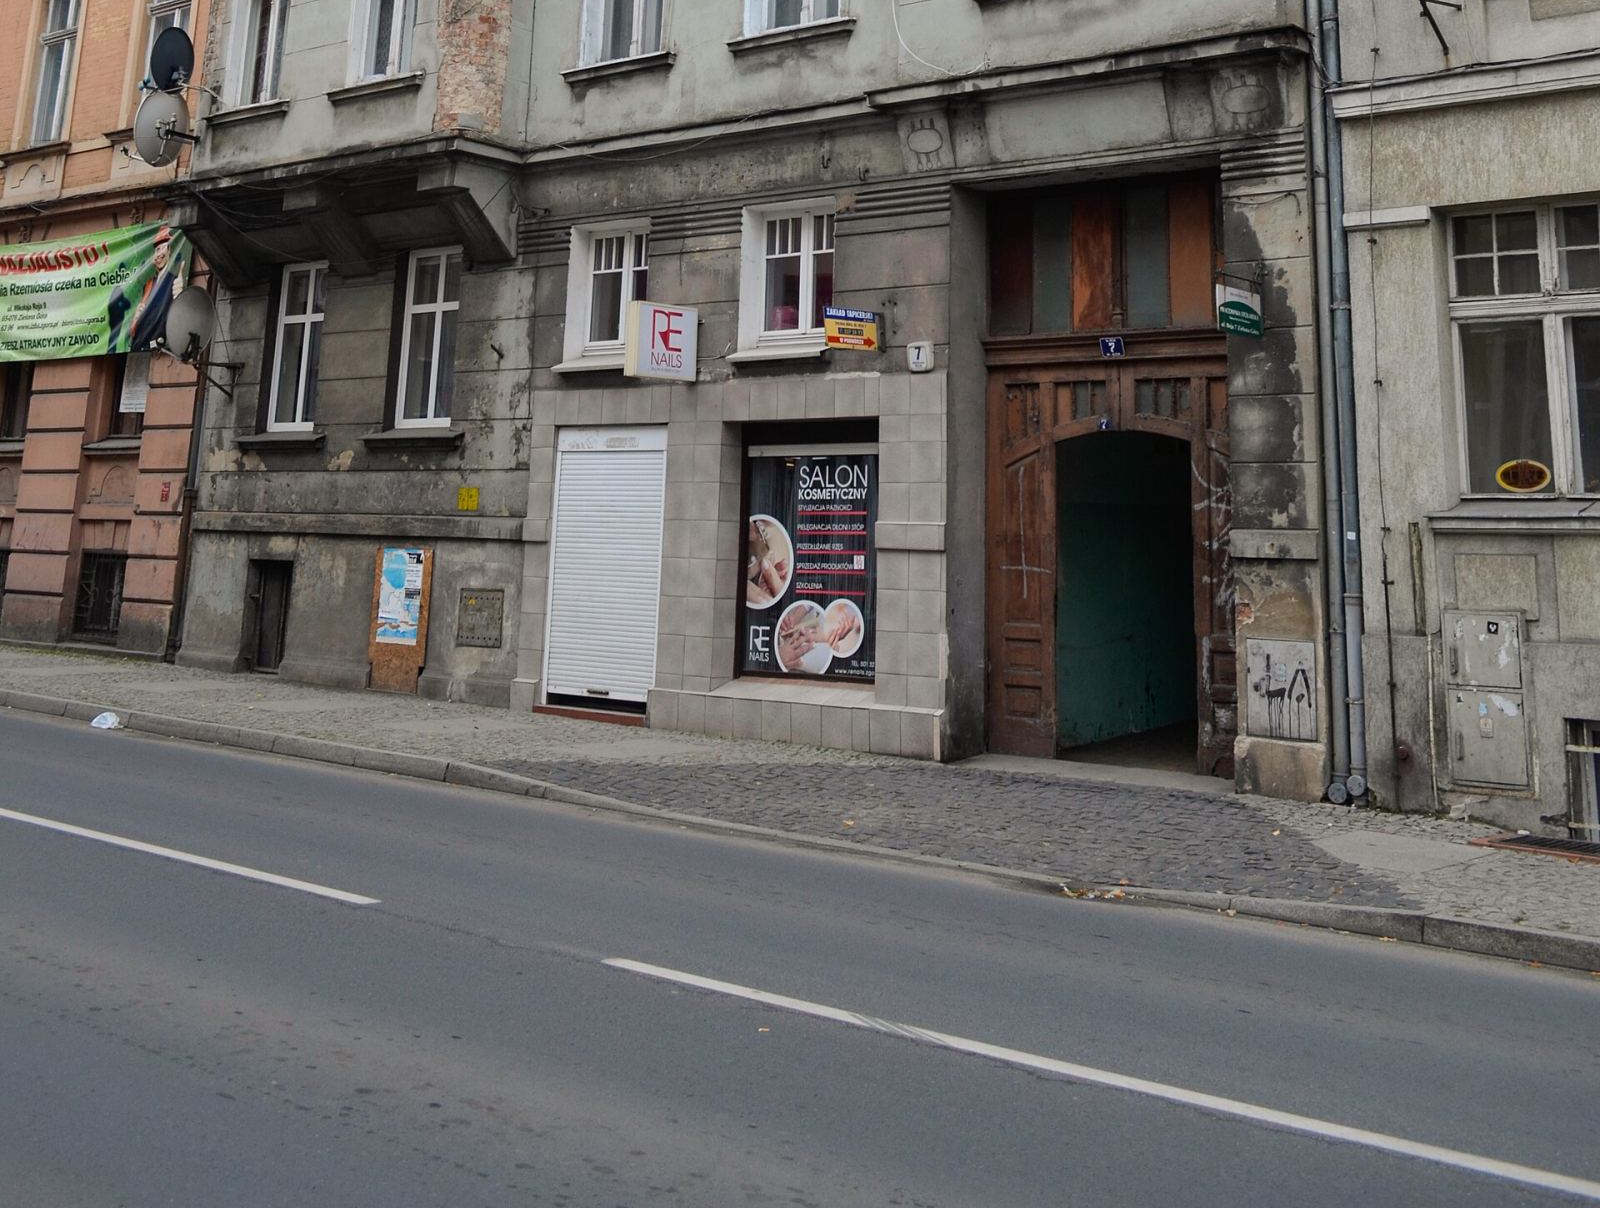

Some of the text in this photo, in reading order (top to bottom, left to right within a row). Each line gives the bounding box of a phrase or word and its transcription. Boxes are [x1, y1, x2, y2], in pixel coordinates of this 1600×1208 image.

[10, 280, 53, 295] Rzemiosła
[55, 278, 81, 292] czeka
[84, 276, 97, 288] na
[652, 309, 683, 352] RE
[20, 337, 67, 350] ATRAKCYJNY
[69, 332, 100, 346] ZAWÓD
[1108, 342, 1115, 353] 7
[651, 352, 682, 368] NAILS
[914, 346, 921, 360] 7
[1101, 419, 1107, 429] 7
[799, 464, 869, 489] SALON
[798, 488, 867, 500] KOSMETYCZNY
[796, 581, 823, 589] SZKOLENIA
[750, 625, 770, 652] RE
[749, 652, 769, 662] NAILS
